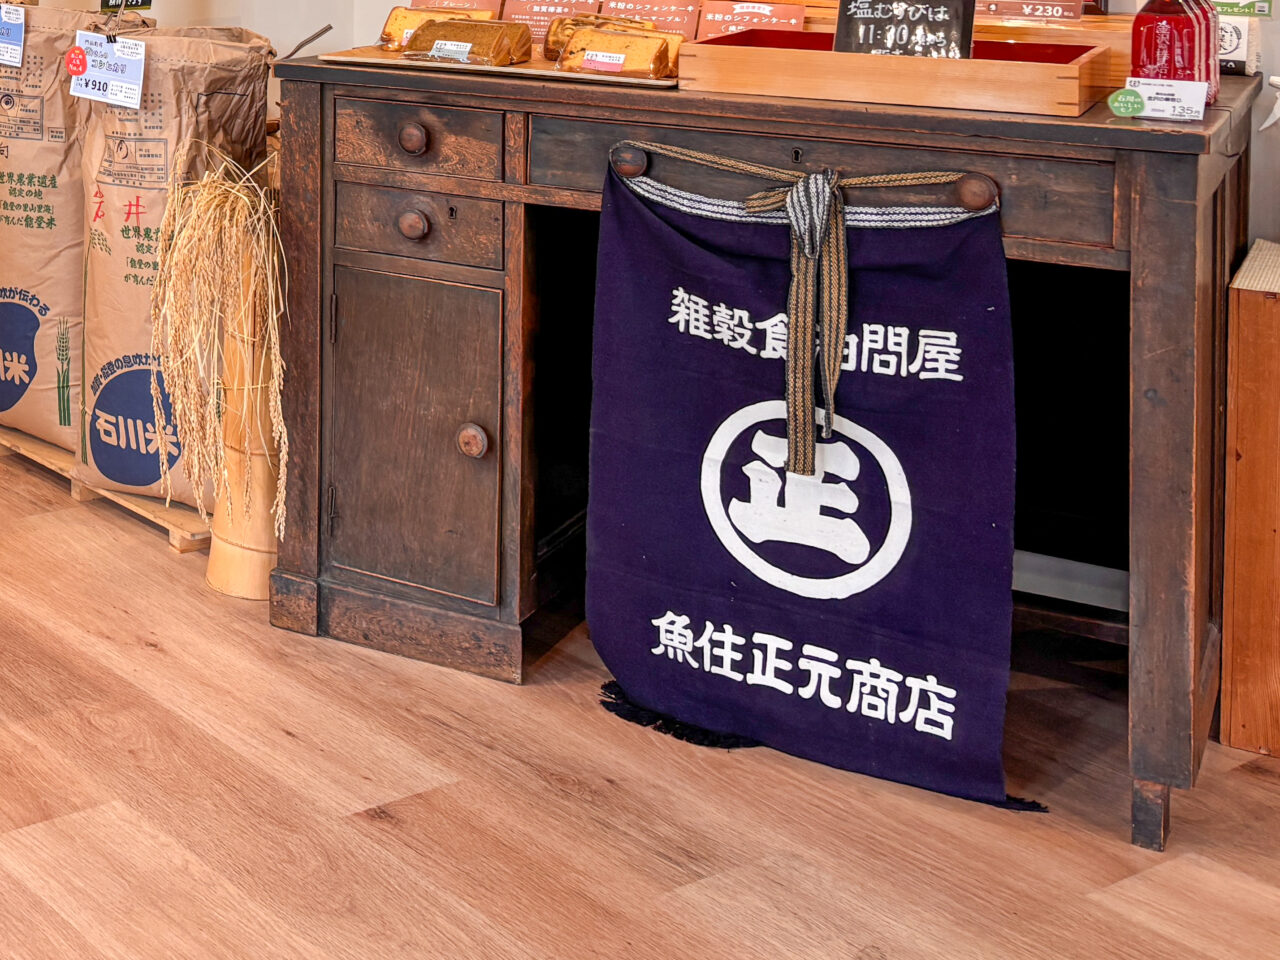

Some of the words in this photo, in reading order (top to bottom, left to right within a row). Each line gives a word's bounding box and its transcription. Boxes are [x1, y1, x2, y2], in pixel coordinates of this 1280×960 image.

[608, 1, 694, 13] 米粉のシフォンケーキ
[1022, 4, 1062, 17] ￥230
[705, 13, 798, 26] 米粉のシフォンケーキ
[91, 59, 127, 74] コシヒカリ
[84, 78, 108, 93] ￥910
[8, 187, 43, 200] 認定の地
[135, 241, 160, 255] 認定
[669, 287, 963, 381] 雑穀食問屋
[95, 408, 179, 457] 石川米
[728, 429, 870, 565] 正
[651, 610, 957, 740] 魚住正元商店
